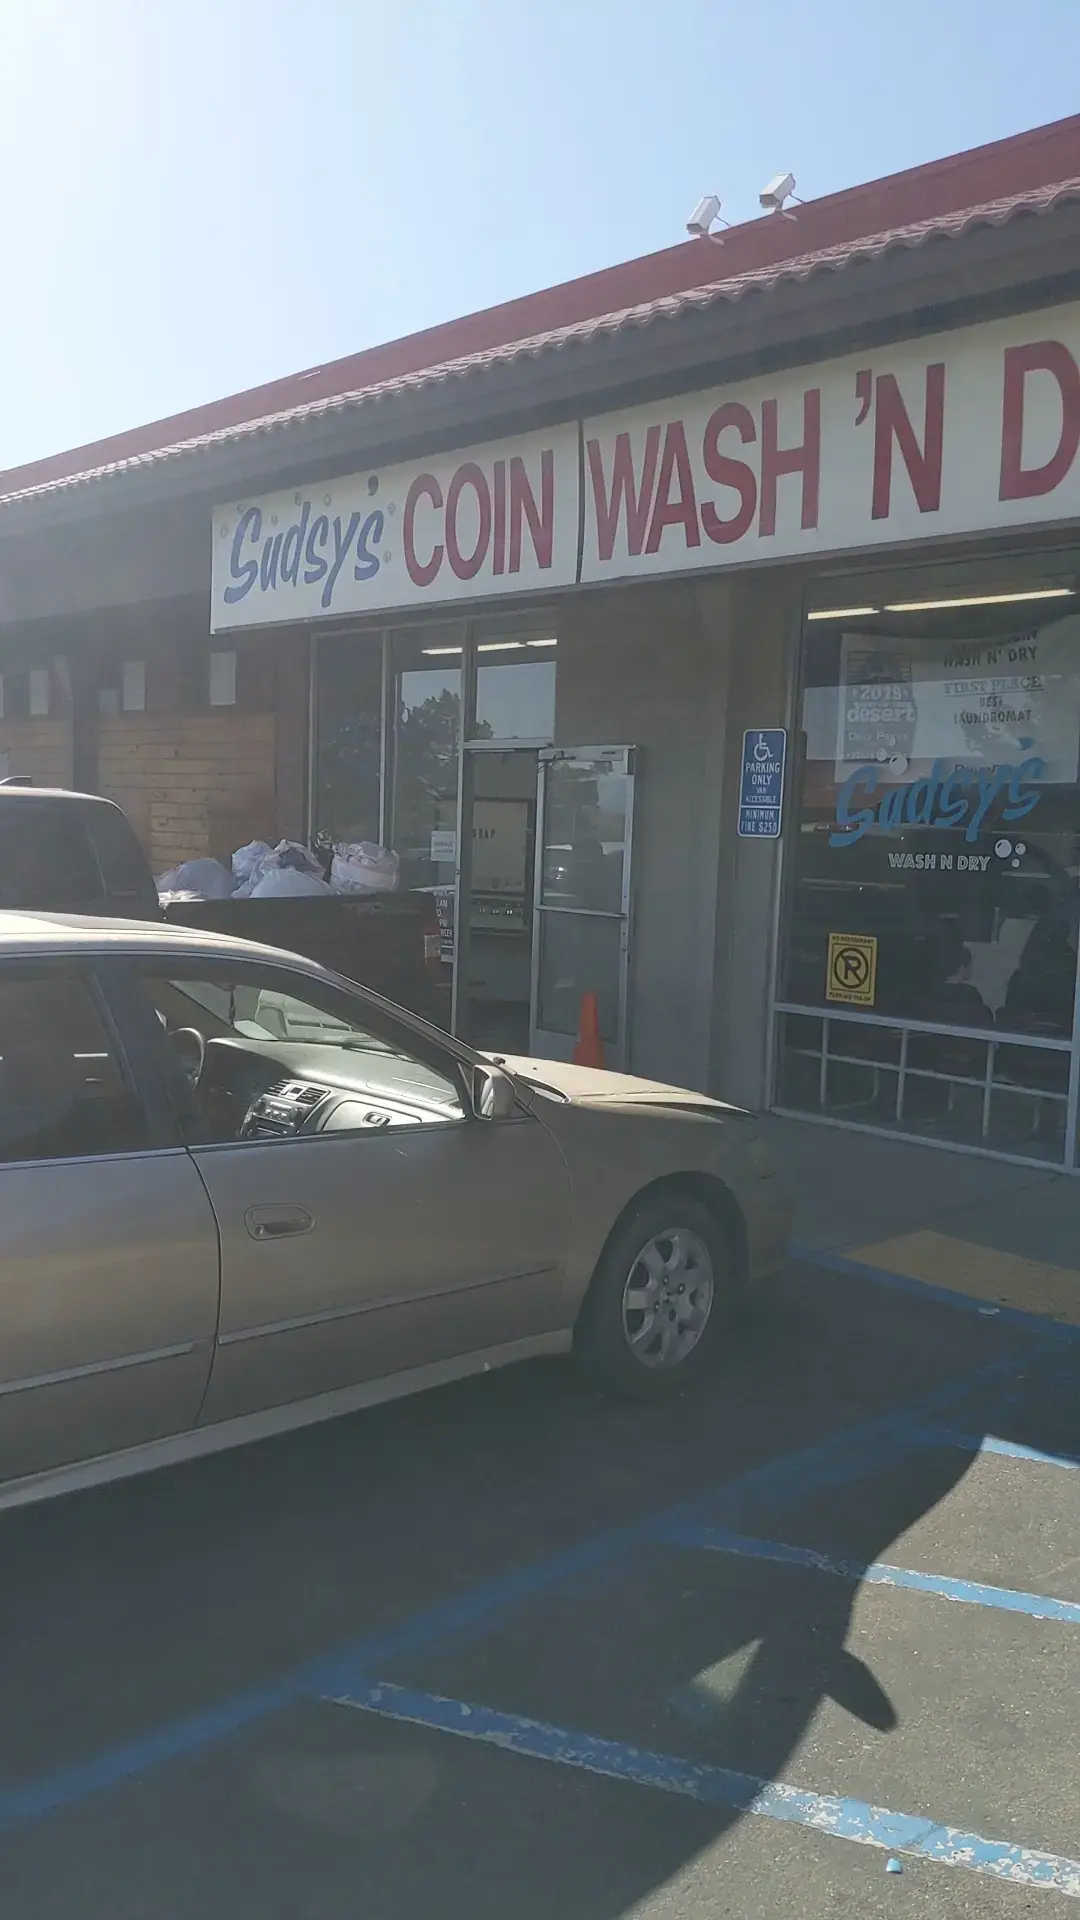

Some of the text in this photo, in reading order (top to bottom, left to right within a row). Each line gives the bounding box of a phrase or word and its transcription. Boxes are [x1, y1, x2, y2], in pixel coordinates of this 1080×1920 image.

[403, 449, 554, 587] COIN
[586, 388, 820, 561] WASH
[943, 648, 982, 668] WASH
[1008, 645, 1038, 662] DRY
[860, 685, 902, 701] 2019
[847, 702, 916, 723] desert
[953, 709, 1032, 725] LAUNDROMAT
[745, 762, 780, 774] PARKING
[751, 774, 772, 786] ONLY
[755, 786, 767, 794] VAN
[745, 795, 776, 805] ACCESSIBLE
[745, 810, 776, 821] MINIMUM
[741, 821, 756, 832] FINE
[472, 829, 495, 840] SOAP
[888, 853, 990, 872] WASH N DRY
